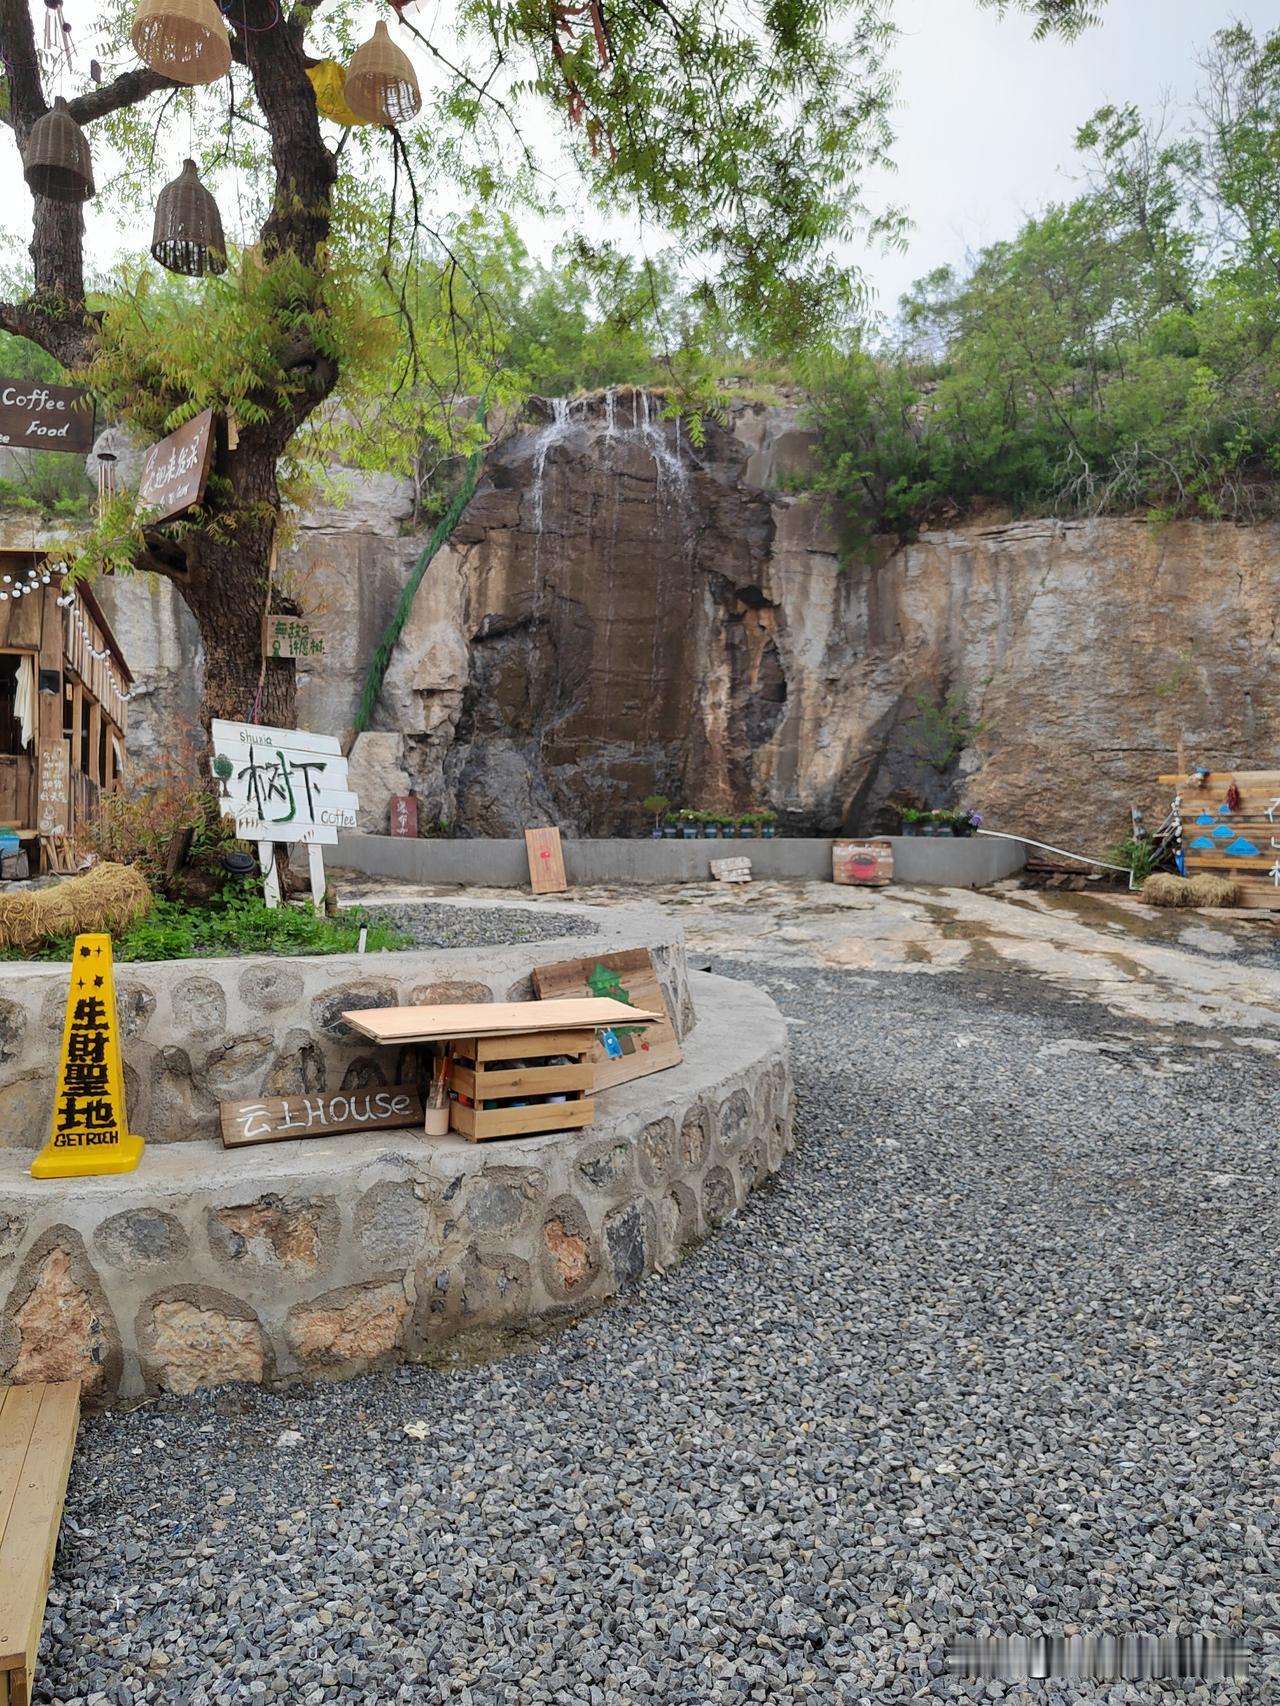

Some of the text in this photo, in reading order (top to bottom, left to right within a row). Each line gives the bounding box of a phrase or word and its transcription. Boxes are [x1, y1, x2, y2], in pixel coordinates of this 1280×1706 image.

[2, 387, 66, 411] Coffee
[25, 420, 70, 437] Food
[237, 742, 327, 823] 树下
[57, 996, 118, 1132] 生財聖地
